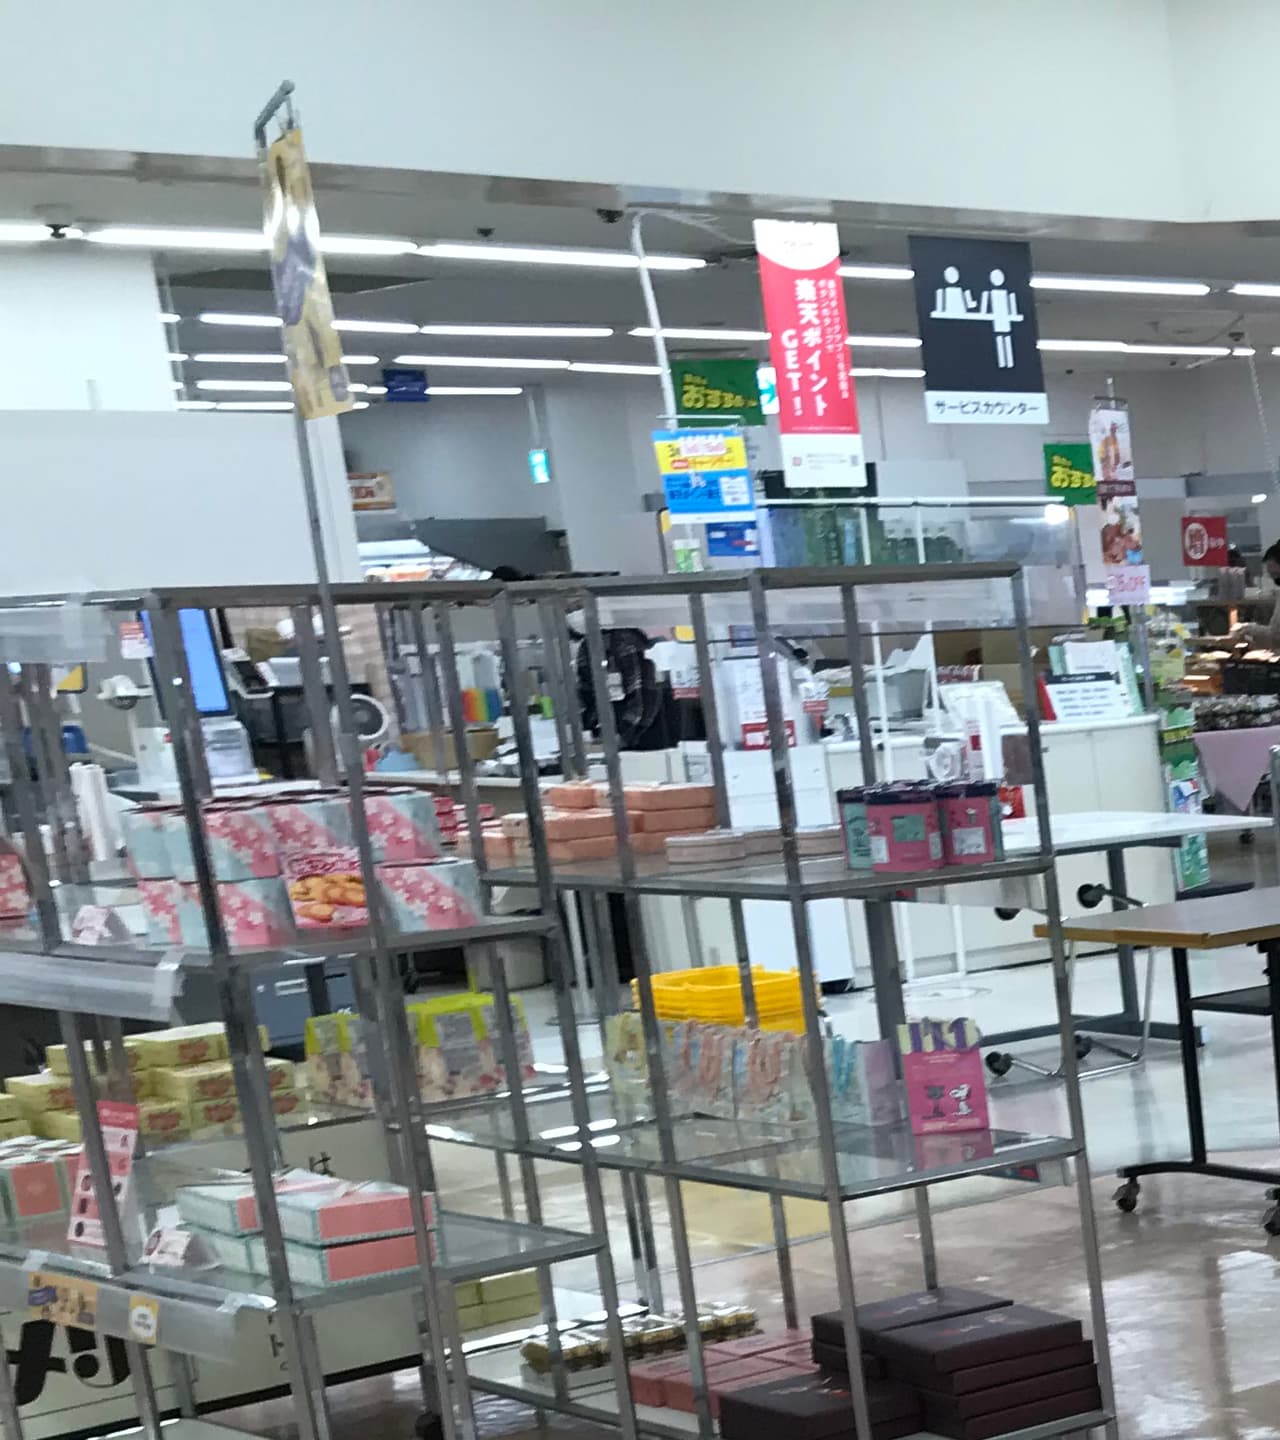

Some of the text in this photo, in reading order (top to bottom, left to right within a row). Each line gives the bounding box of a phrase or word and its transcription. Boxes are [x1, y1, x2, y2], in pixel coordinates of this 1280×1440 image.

[794, 278, 828, 417] 楽天ポイント
[935, 400, 1040, 416] サービスカウンター
